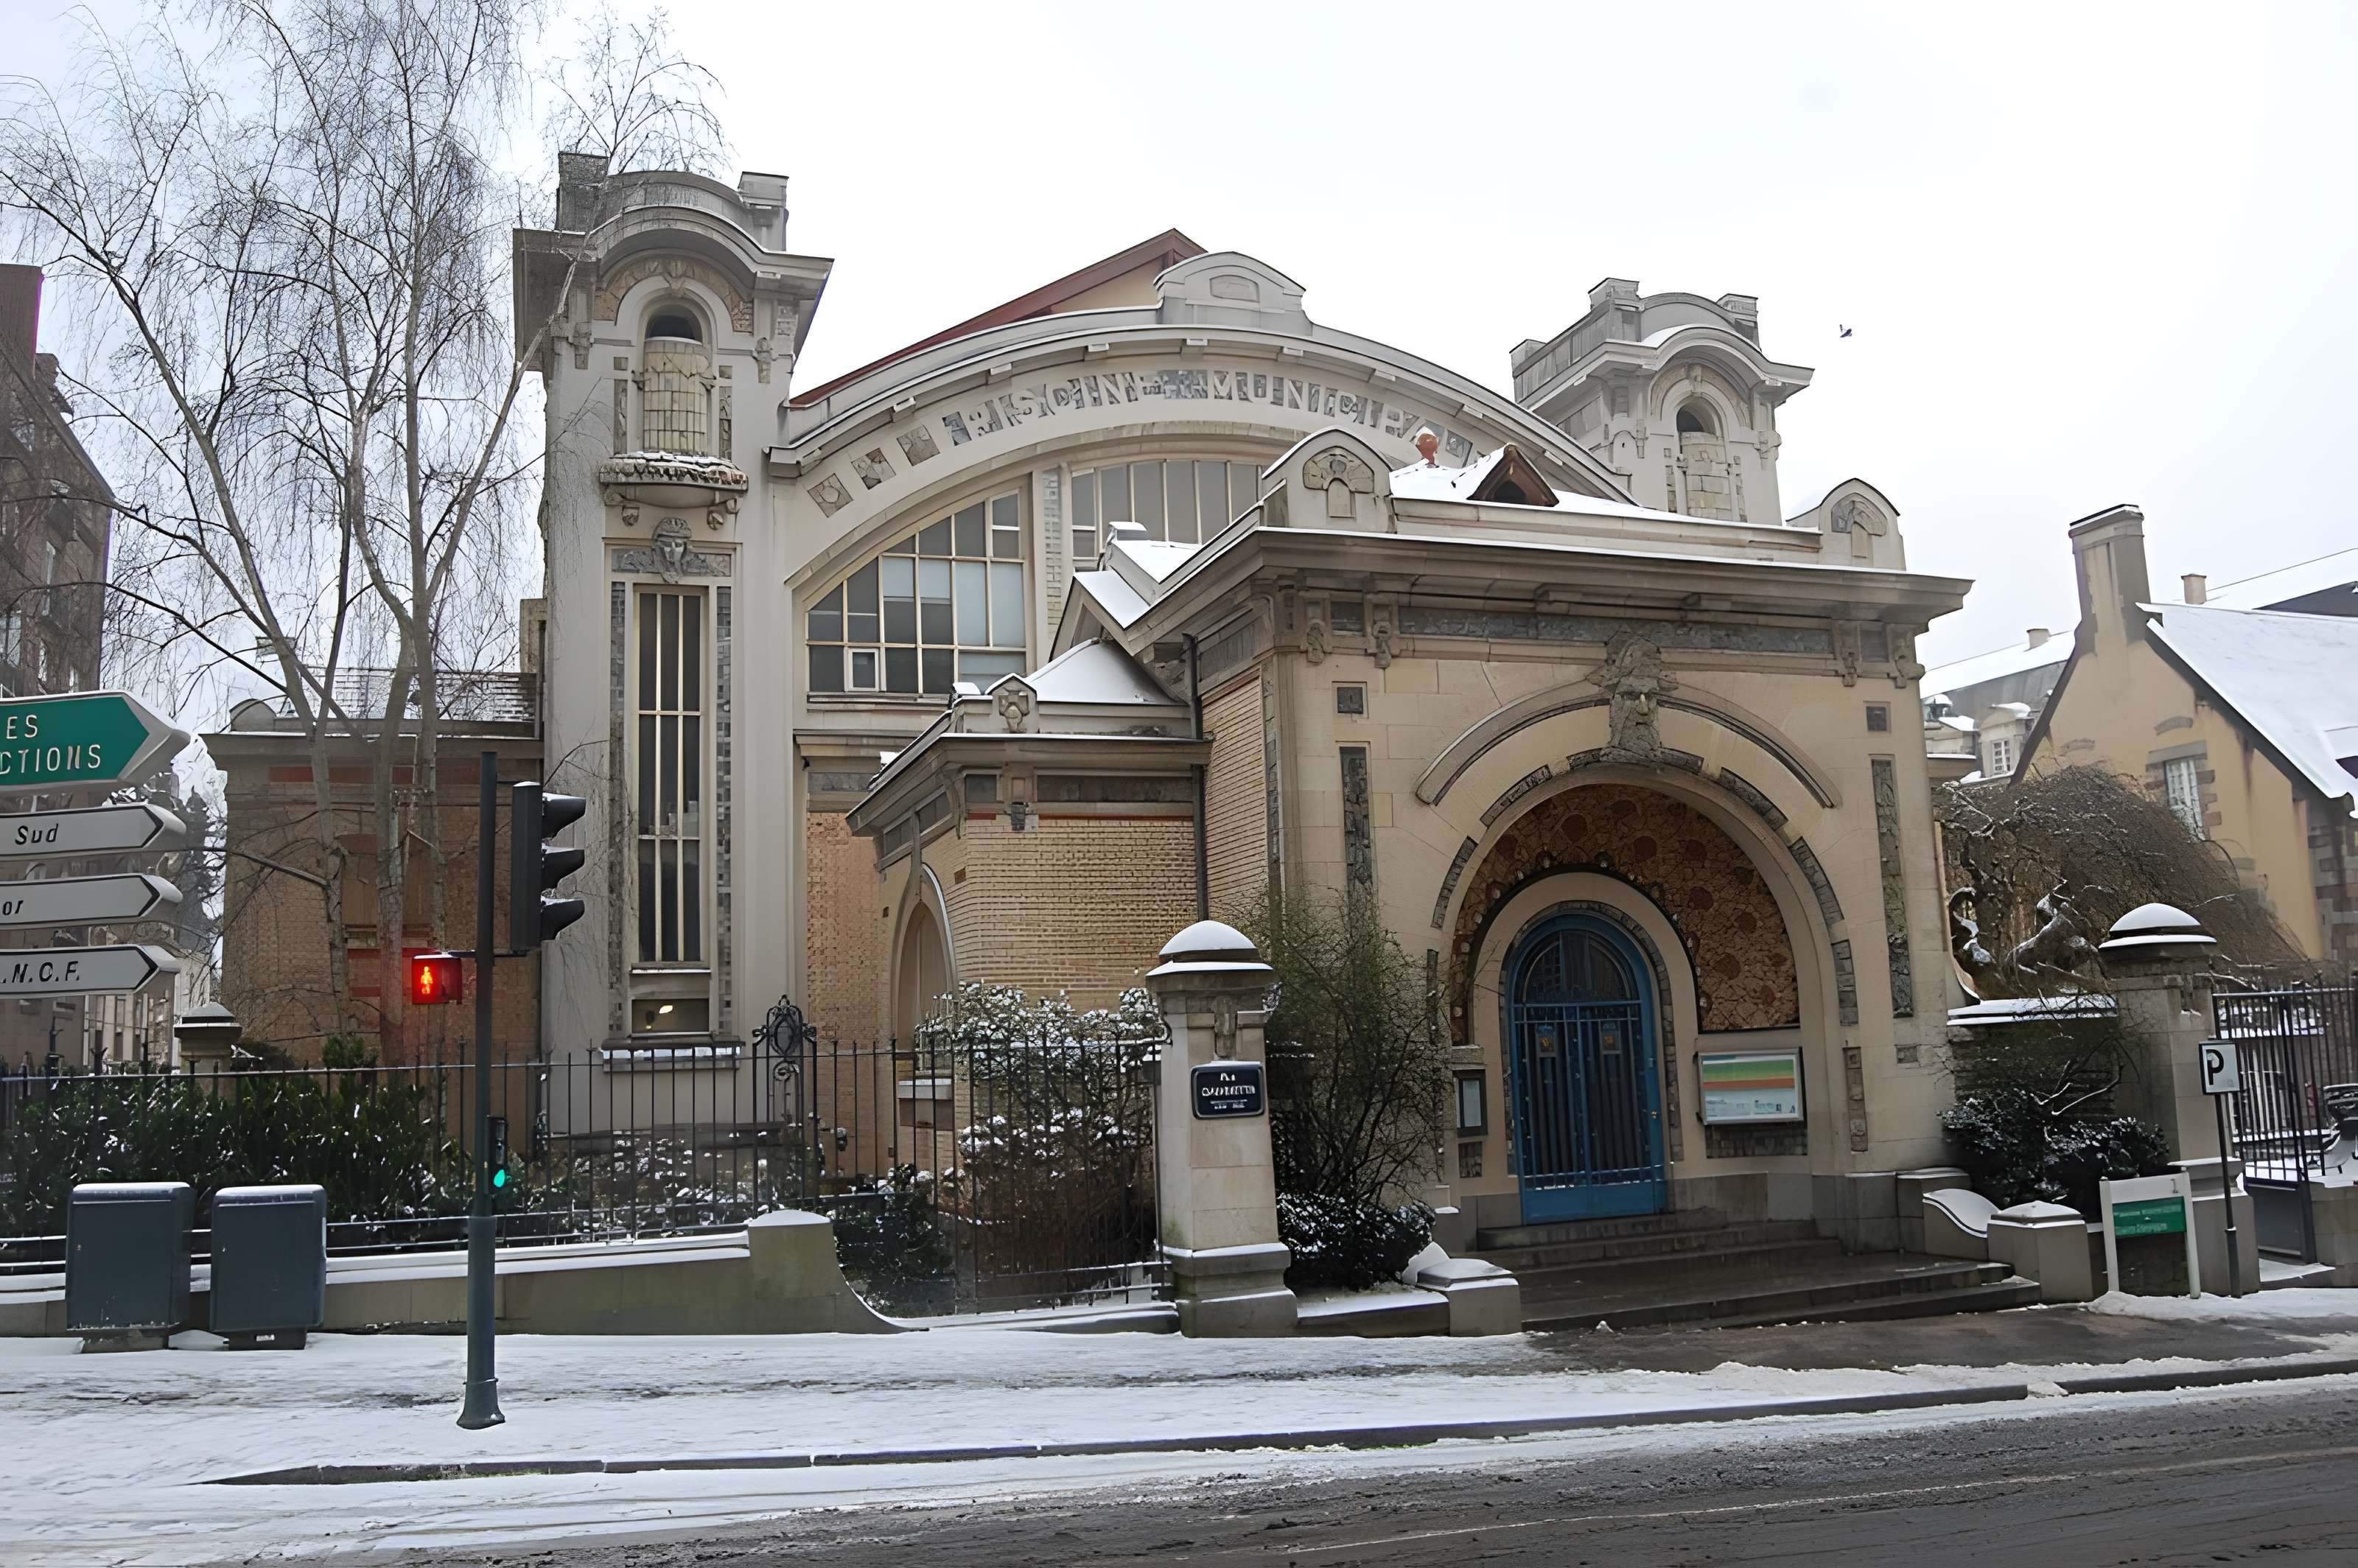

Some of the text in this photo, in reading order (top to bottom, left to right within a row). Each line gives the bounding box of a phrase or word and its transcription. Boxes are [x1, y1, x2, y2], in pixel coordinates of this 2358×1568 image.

[6, 714, 38, 739] ES
[0, 744, 101, 774] CTIONS
[15, 823, 59, 845] Sud
[2, 900, 24, 915] or
[2205, 1049, 2224, 1085] P
